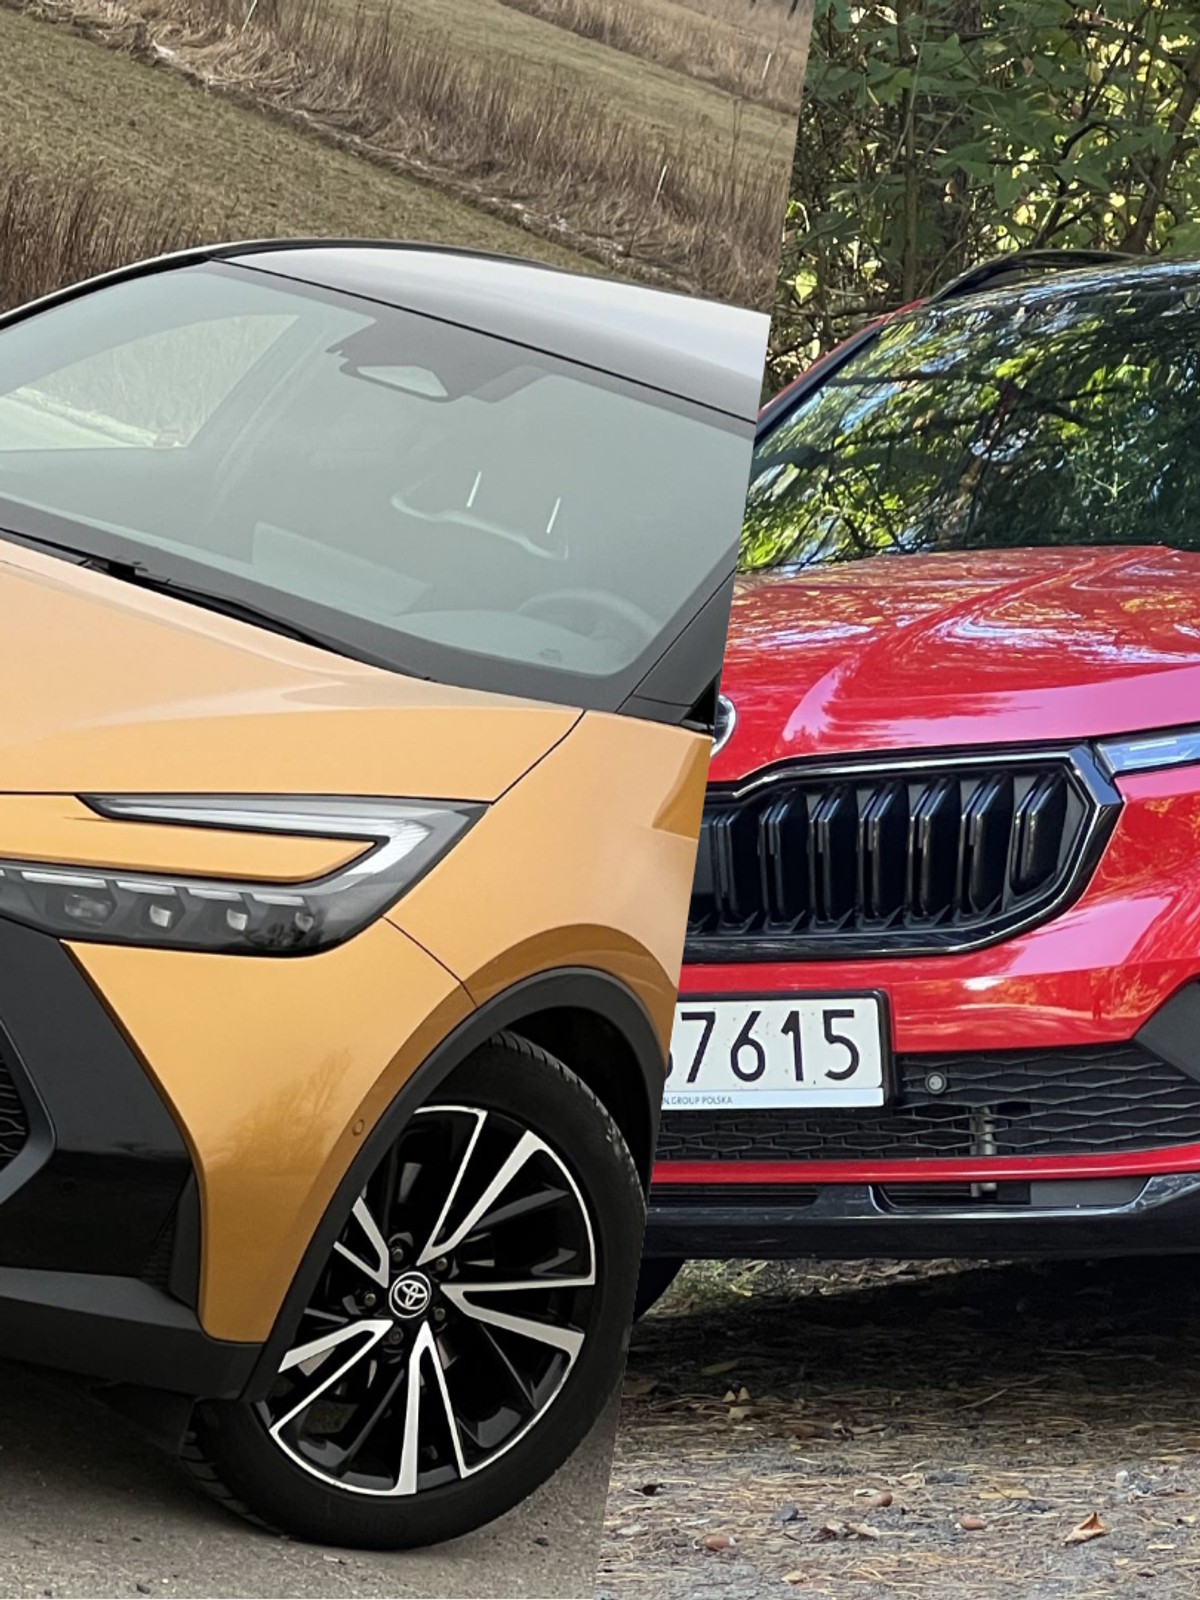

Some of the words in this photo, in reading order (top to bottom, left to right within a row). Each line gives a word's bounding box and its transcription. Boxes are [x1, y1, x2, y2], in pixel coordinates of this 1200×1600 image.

[667, 1010, 860, 1083] 7615
[671, 1096, 700, 1105] GROUP
[701, 1095, 733, 1105] POLSKA
